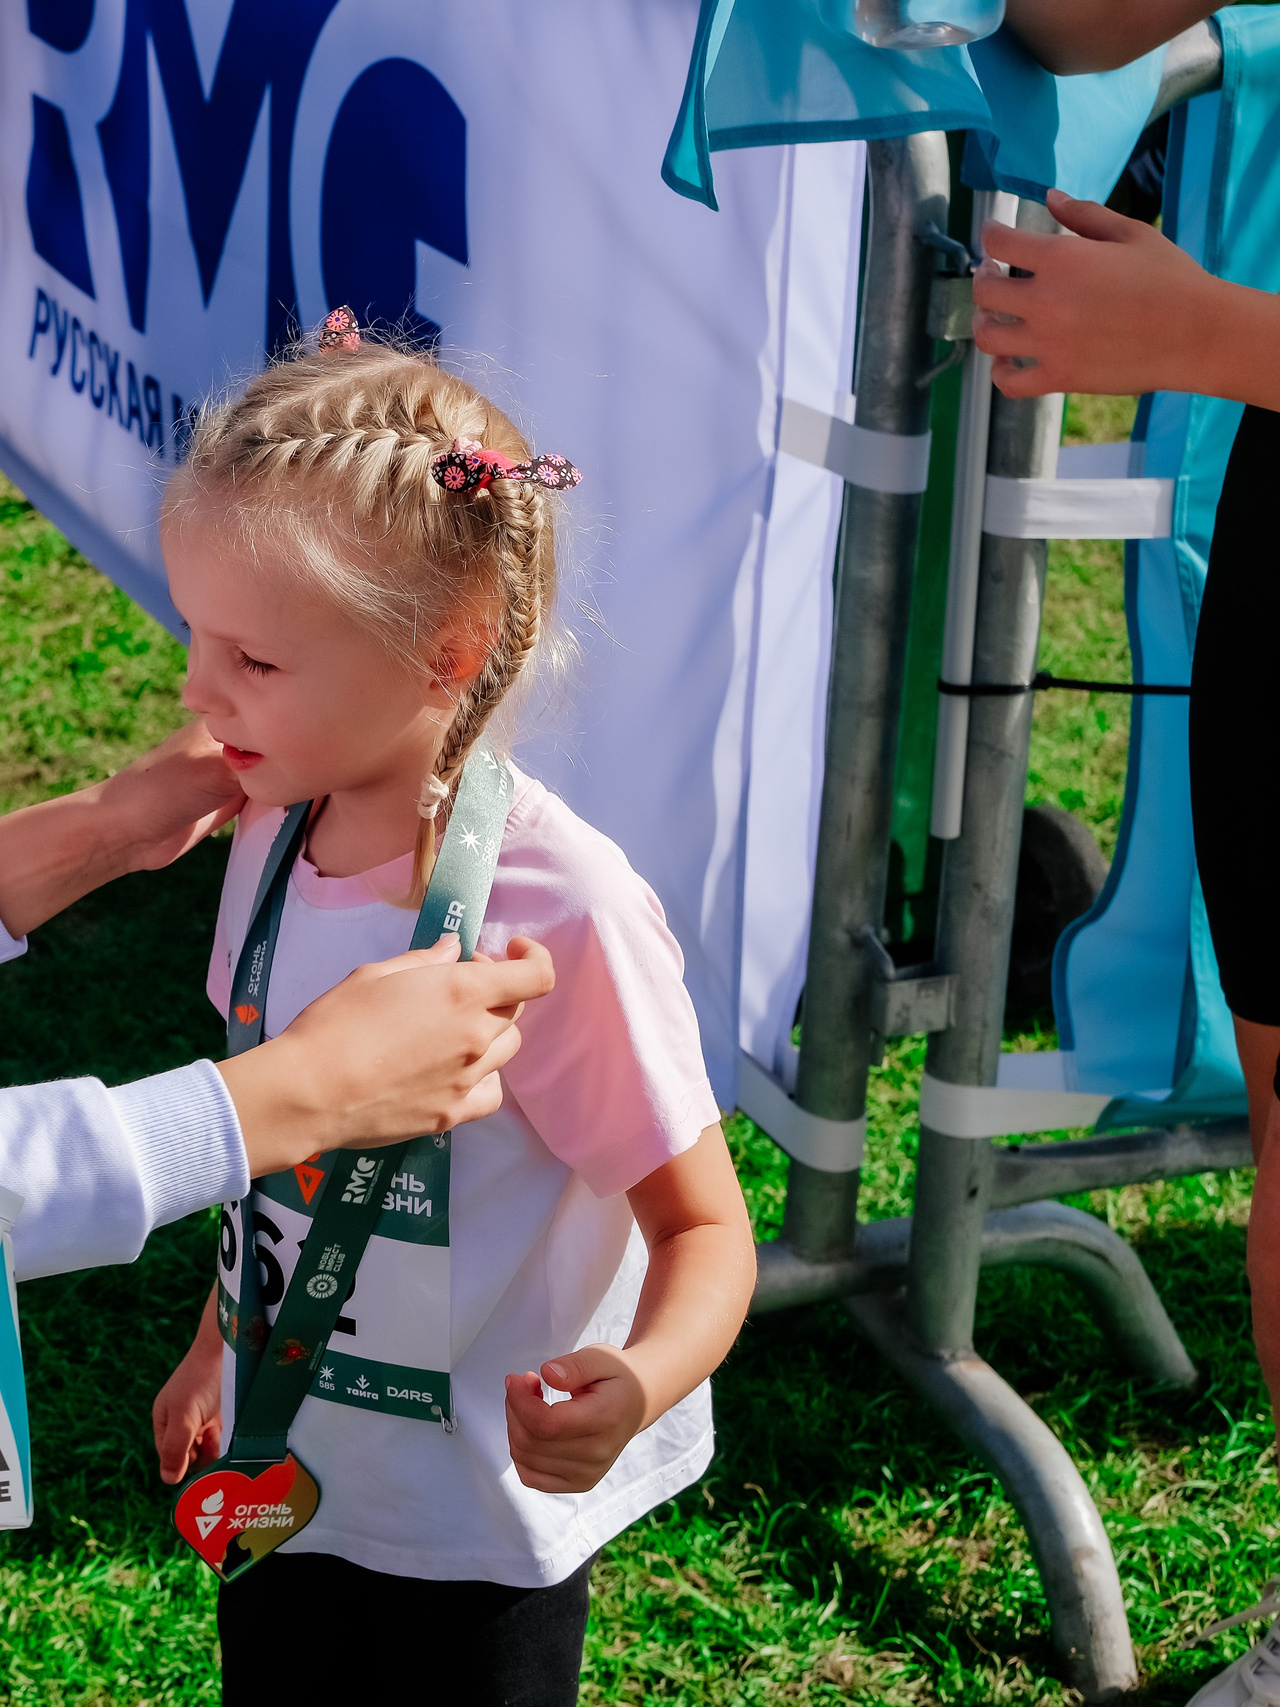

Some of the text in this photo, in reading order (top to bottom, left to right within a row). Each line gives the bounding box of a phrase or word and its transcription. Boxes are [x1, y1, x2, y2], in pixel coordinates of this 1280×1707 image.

[28, 286, 165, 458] РУССКАЯ
[482, 839, 497, 865] 585
[247, 944, 262, 993] ОГОНЬ
[252, 940, 268, 997] ЖИЗНИ
[381, 1191, 432, 1218] ЗНИ
[317, 1246, 333, 1271] NOBLE
[325, 1243, 342, 1272] IMPACT
[333, 1253, 346, 1273] CLUB
[318, 1379, 336, 1391] 585
[386, 1385, 434, 1404] DARS
[226, 1515, 295, 1530] ЖИЗНИ
[234, 1503, 293, 1517] ОГОНЬ
